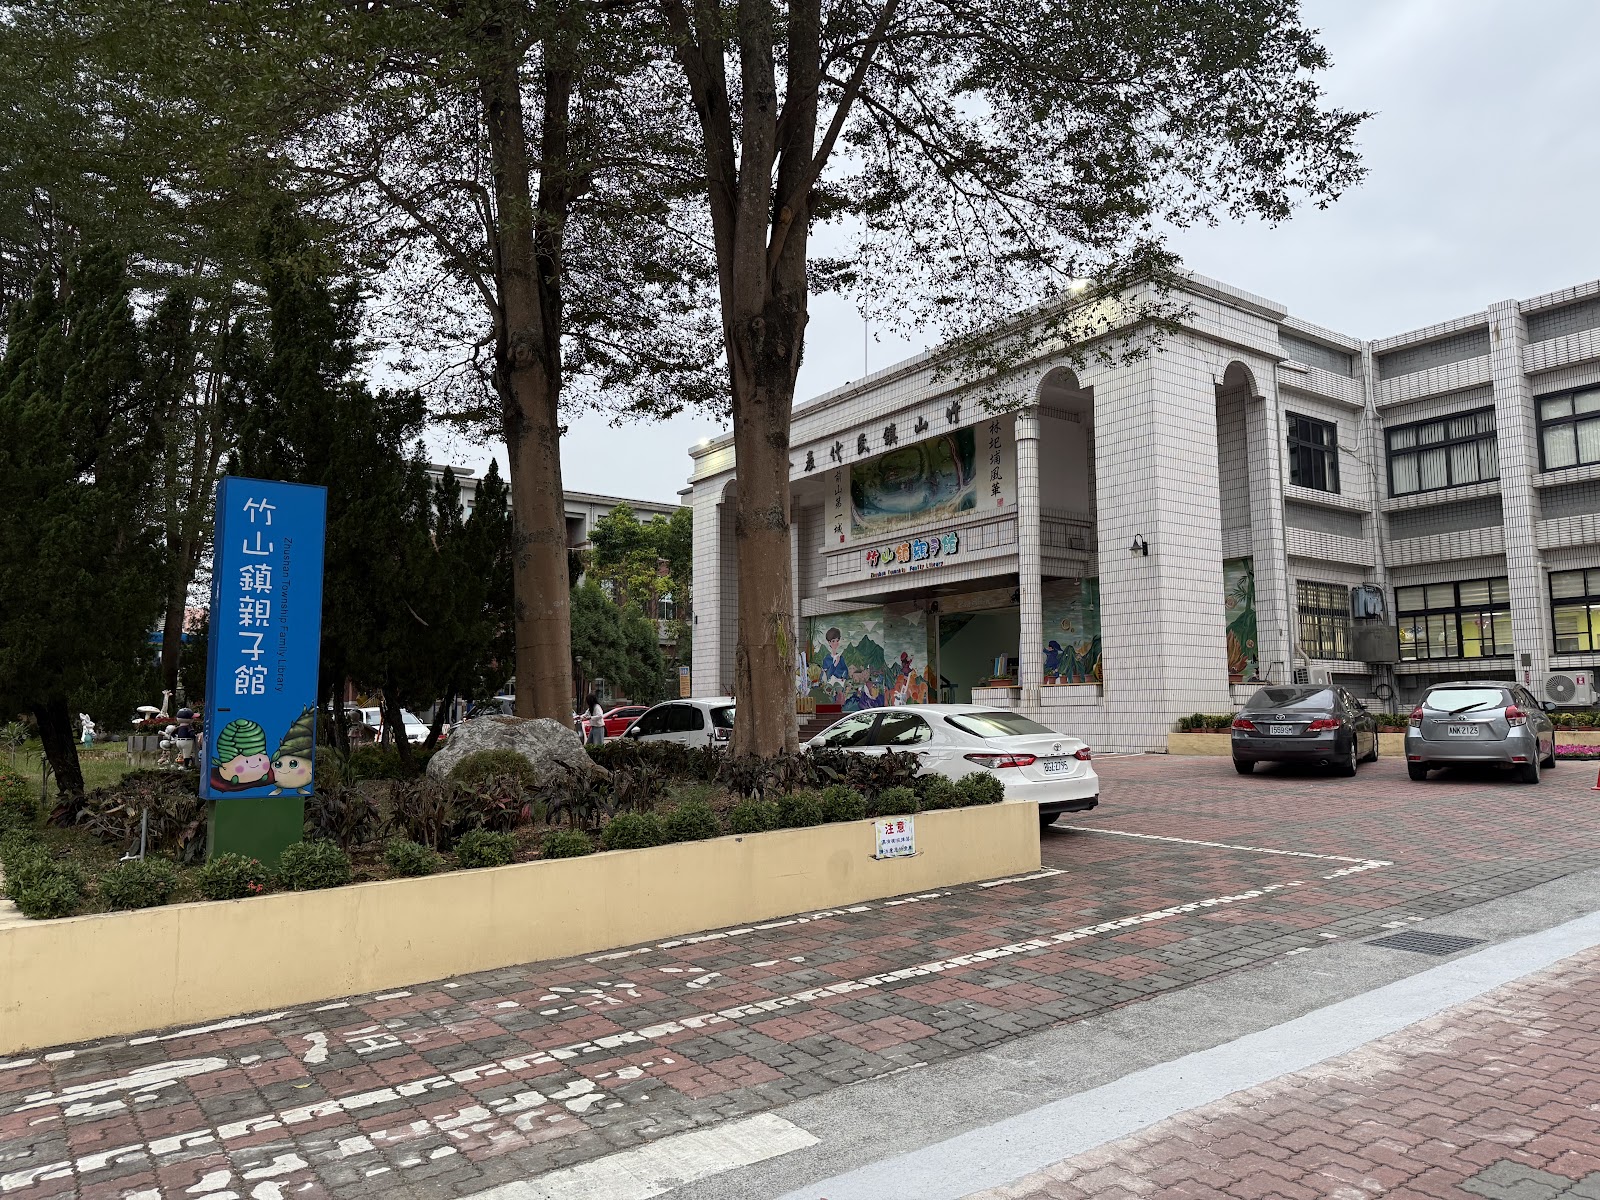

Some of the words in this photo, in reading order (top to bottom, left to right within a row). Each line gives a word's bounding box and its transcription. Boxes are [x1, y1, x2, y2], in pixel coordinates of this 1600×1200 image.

[789, 400, 962, 473] 竹山鎮民代表
[283, 537, 293, 578] Zhushan
[866, 531, 959, 567] 竹山鎮親子館
[234, 497, 277, 696] 竹山鎮親子館
[279, 580, 291, 624] Township
[276, 626, 289, 657] Family
[274, 659, 287, 693] Library
[884, 820, 906, 835] 注意
